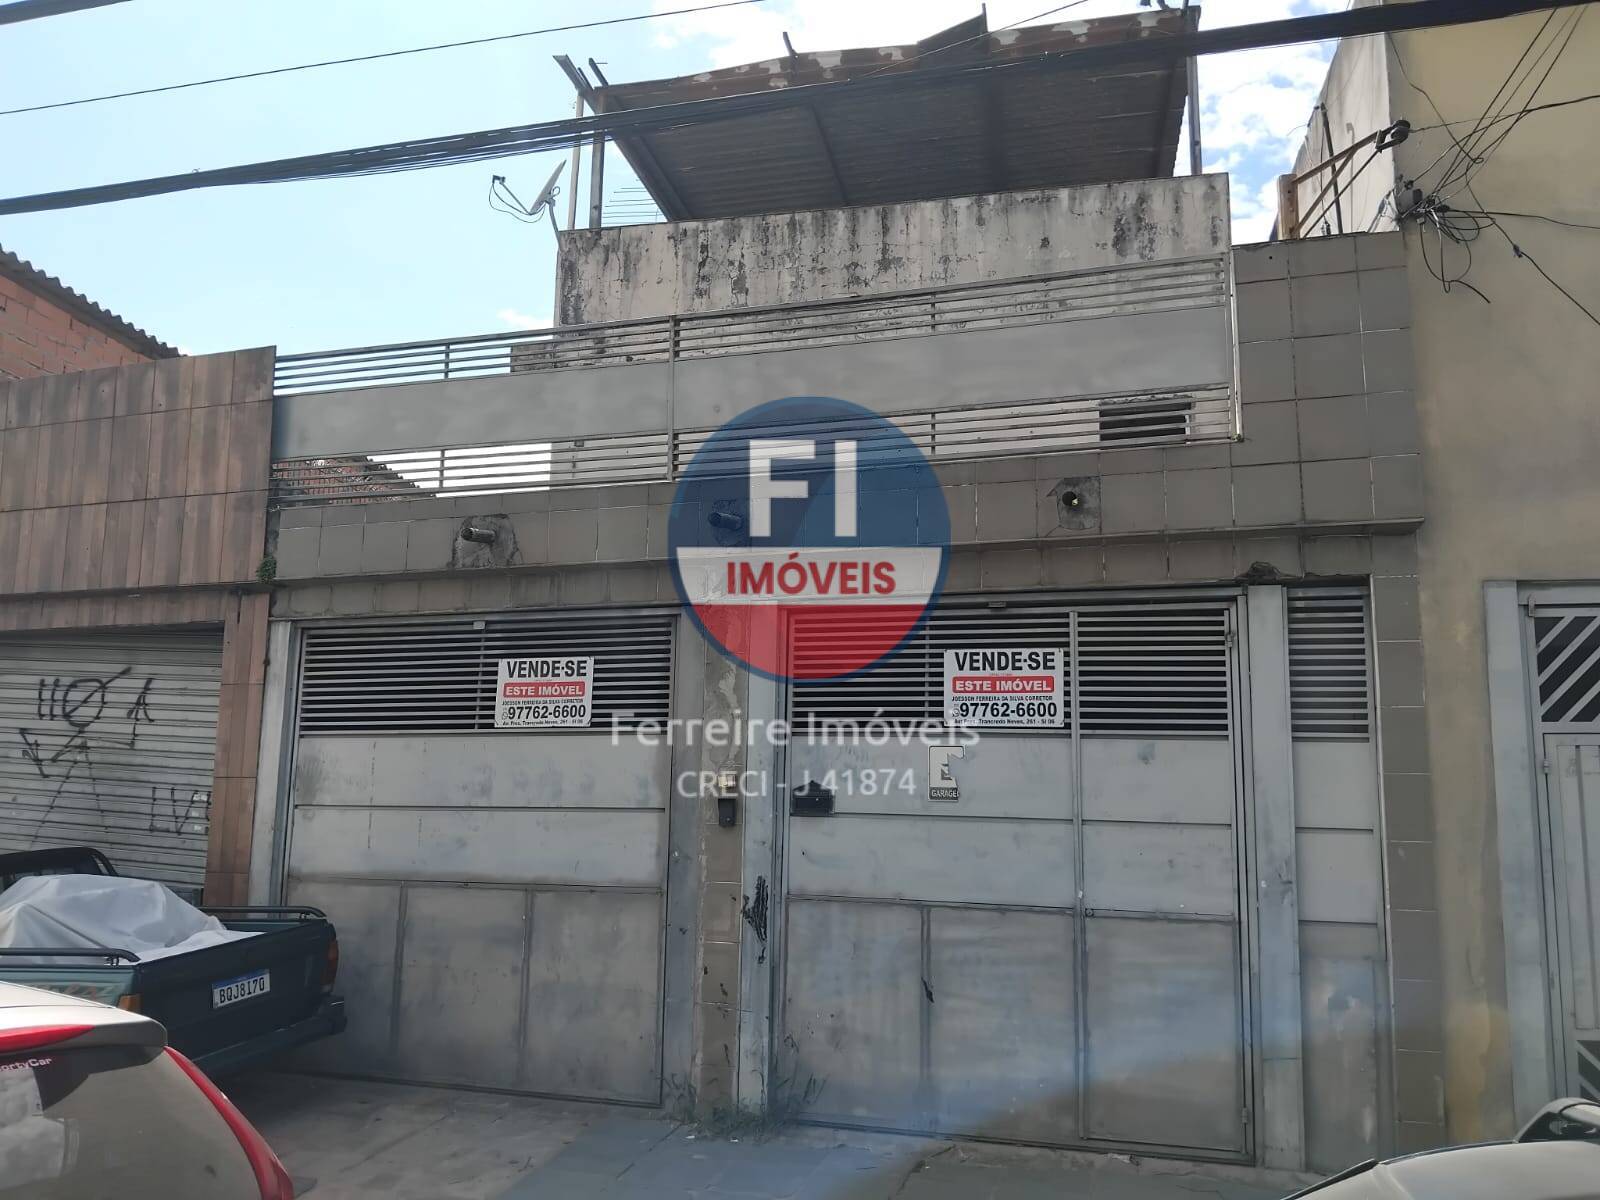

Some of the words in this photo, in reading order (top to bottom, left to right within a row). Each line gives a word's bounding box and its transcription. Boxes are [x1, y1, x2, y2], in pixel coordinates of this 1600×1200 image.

[954, 651, 1056, 671] VENDE-SE
[507, 660, 588, 678] VENDE-SE
[505, 686, 536, 696] ESTE
[538, 683, 583, 695] IMÓVEL
[955, 680, 992, 691] ESTE
[996, 678, 1052, 691] IMÓVEL
[508, 704, 586, 720] 97762-6600
[960, 702, 1057, 717] 97762-6600
[0, 1057, 53, 1072] ortyCar
